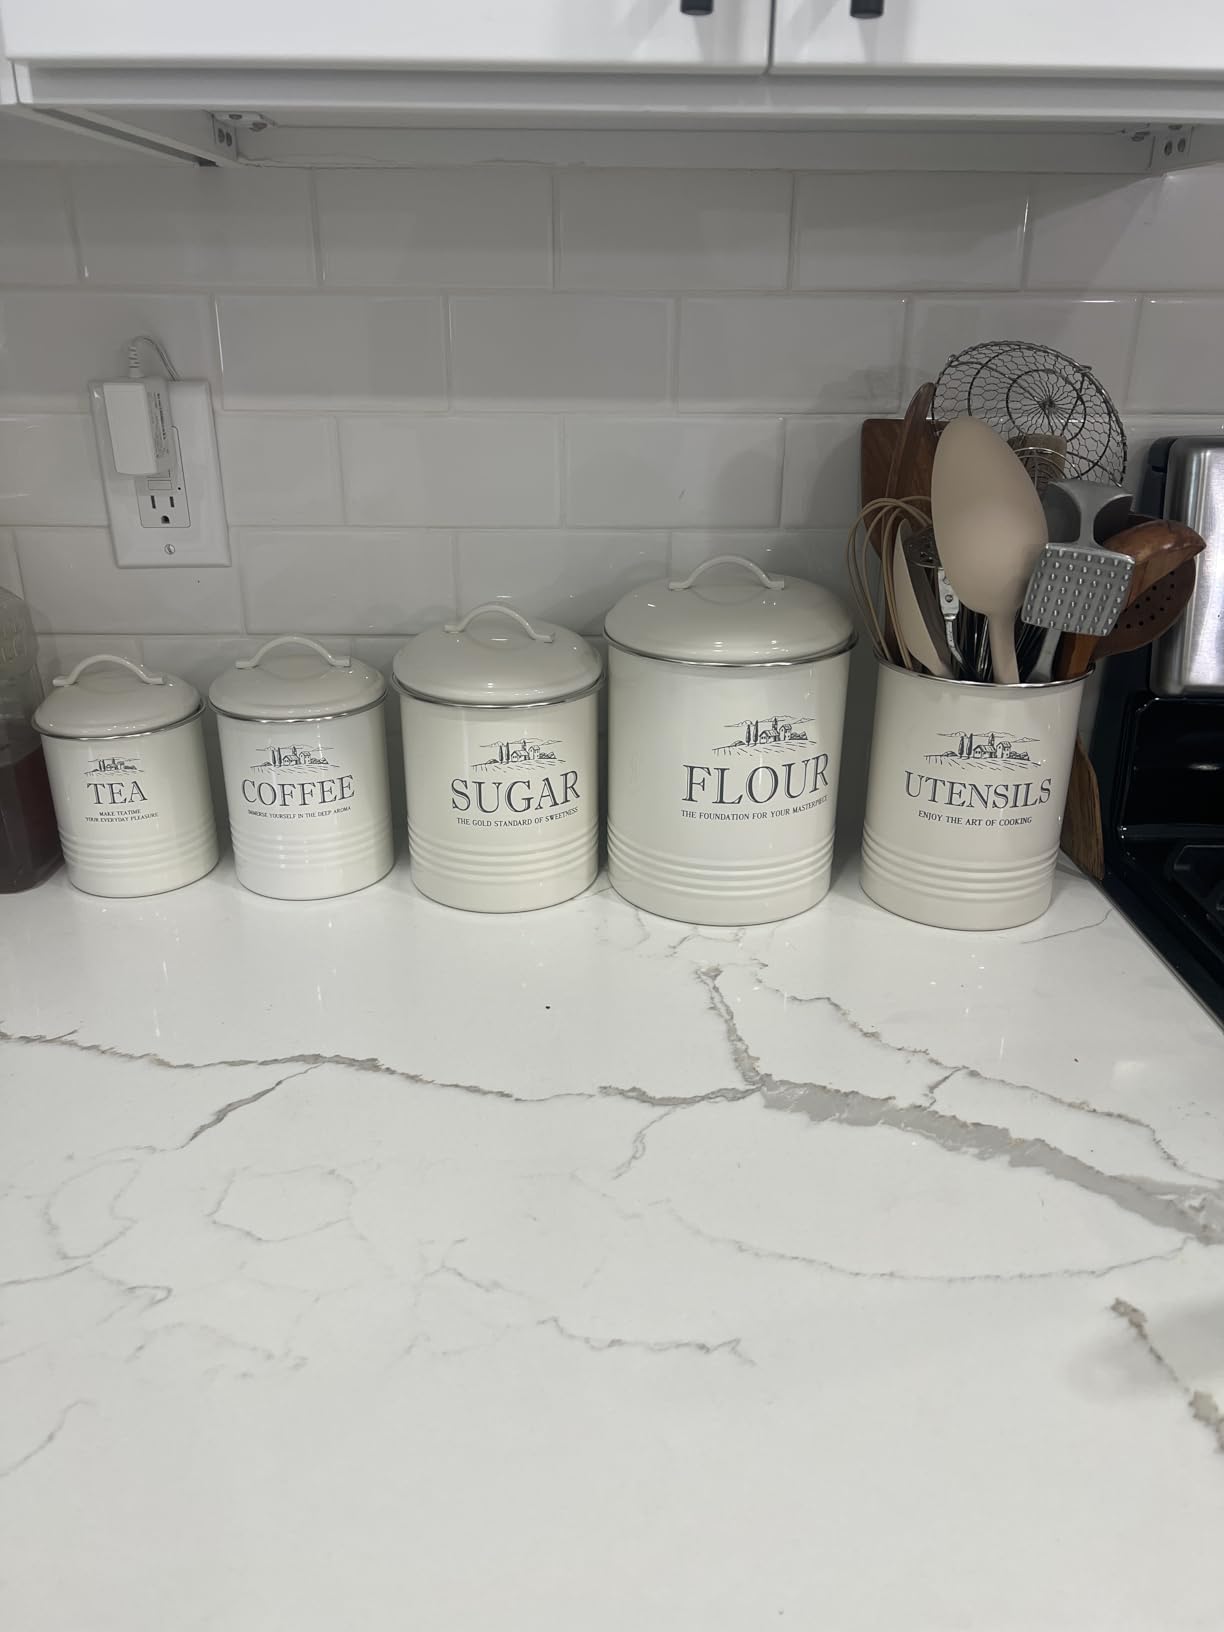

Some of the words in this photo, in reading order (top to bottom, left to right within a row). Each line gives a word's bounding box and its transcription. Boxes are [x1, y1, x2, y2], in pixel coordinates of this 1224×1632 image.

[241, 774, 355, 807] COFFEE
[451, 770, 581, 814] SUGAR
[681, 753, 829, 805] FLOUR
[904, 770, 1052, 809] UTENSILS
[86, 780, 149, 805] TEA
[131, 812, 159, 821] PLEASURE
[333, 806, 352, 814] AROMA
[457, 817, 471, 826] THE
[472, 819, 492, 827] GOLD
[494, 818, 533, 827] STANDARD
[534, 816, 544, 824] OF
[545, 806, 579, 823] SWEETNESS
[681, 809, 697, 819] THE
[699, 811, 750, 821] FOUNDATION
[752, 811, 768, 820] FOR
[770, 808, 790, 818] YOUR
[792, 794, 829, 814] MASTERPIECE
[918, 809, 943, 821] ENJOY
[945, 815, 963, 825] THE
[965, 818, 983, 826] ART
[985, 818, 997, 827] OF
[998, 816, 1033, 827] COOKING
